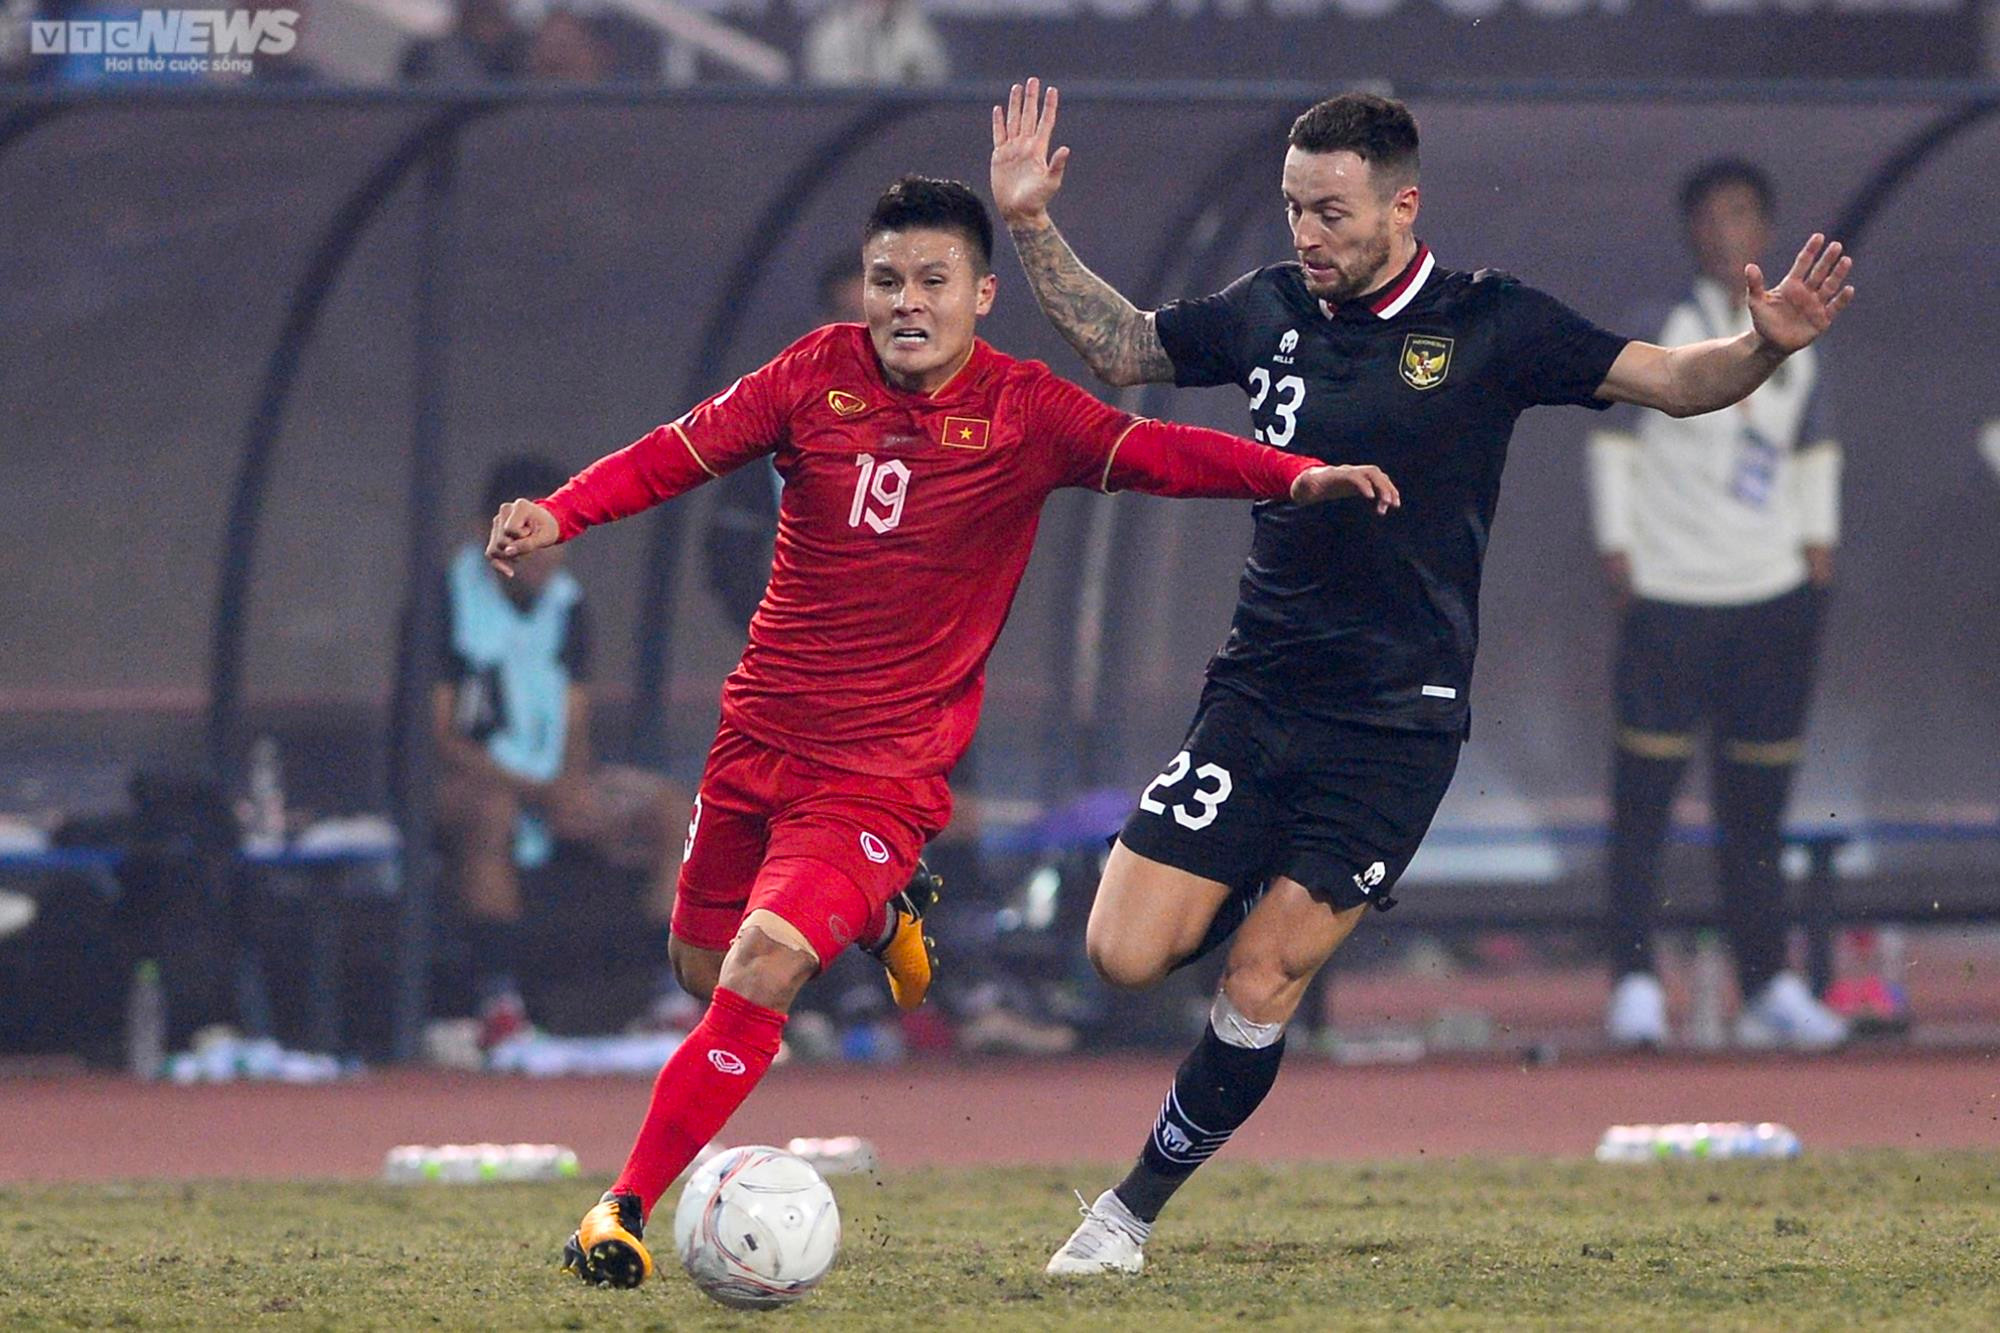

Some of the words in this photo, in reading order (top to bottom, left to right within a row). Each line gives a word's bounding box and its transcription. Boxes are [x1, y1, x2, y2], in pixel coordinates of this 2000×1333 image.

[1248, 366, 1306, 447] 23
[848, 453, 912, 534] 19
[1140, 750, 1233, 831] 23
